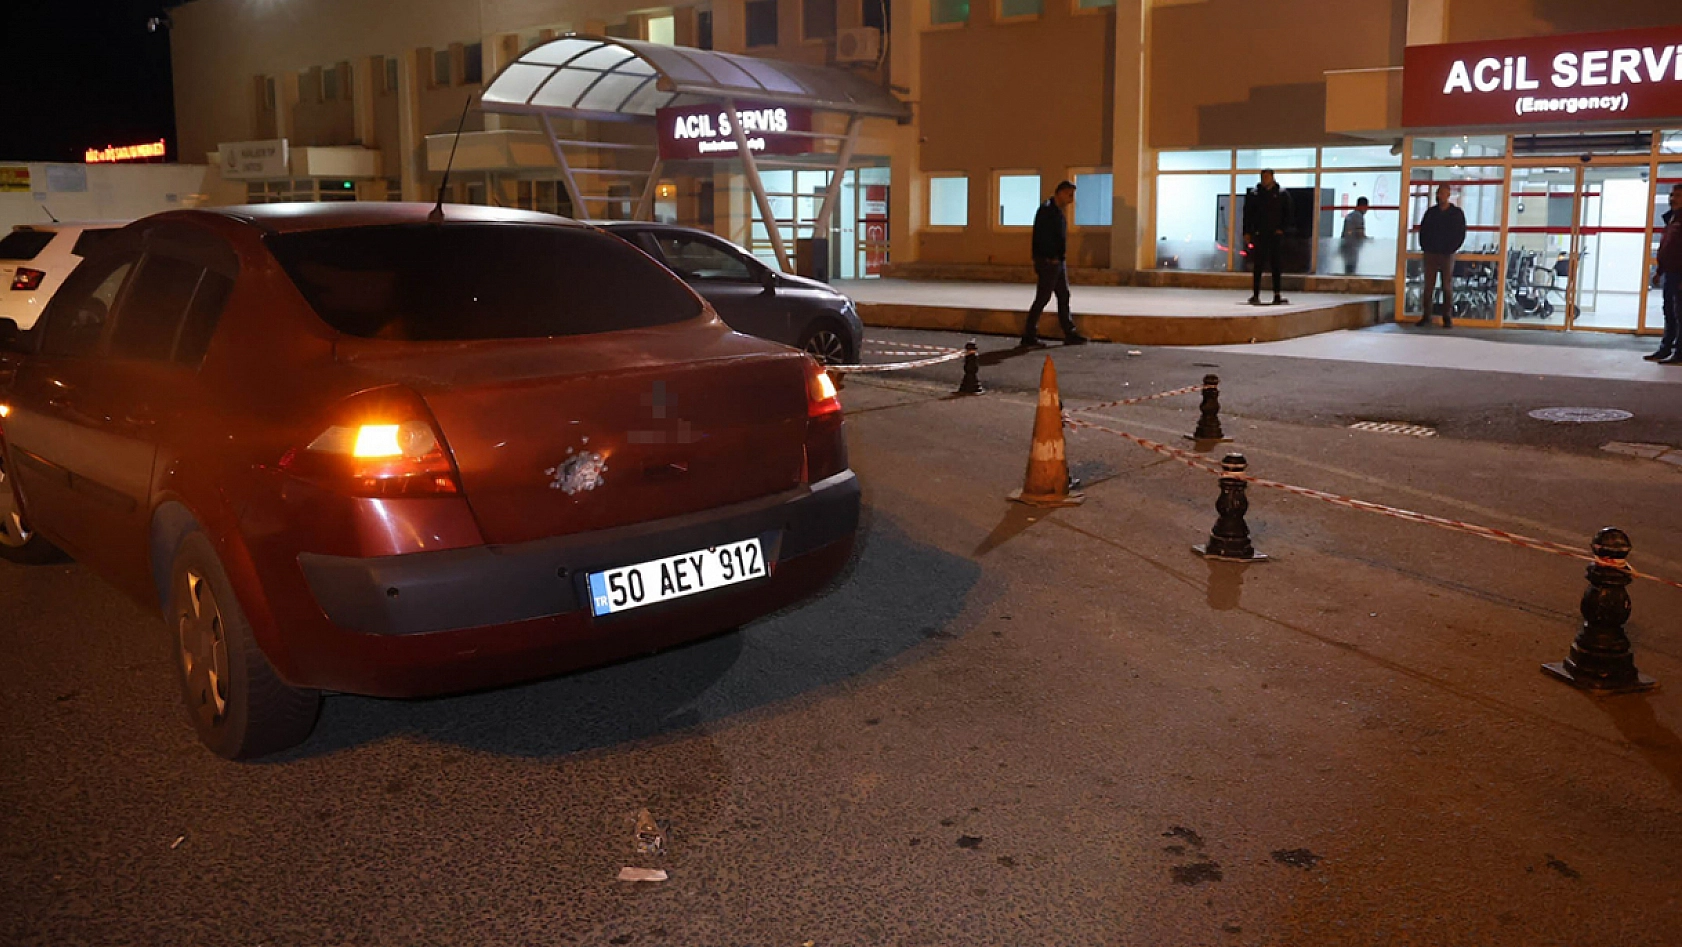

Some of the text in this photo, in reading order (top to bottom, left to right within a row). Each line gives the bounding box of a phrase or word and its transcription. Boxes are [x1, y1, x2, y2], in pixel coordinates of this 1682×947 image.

[1515, 92, 1629, 116] (Emergency)
[595, 543, 762, 607] TR 50 AEY 912
